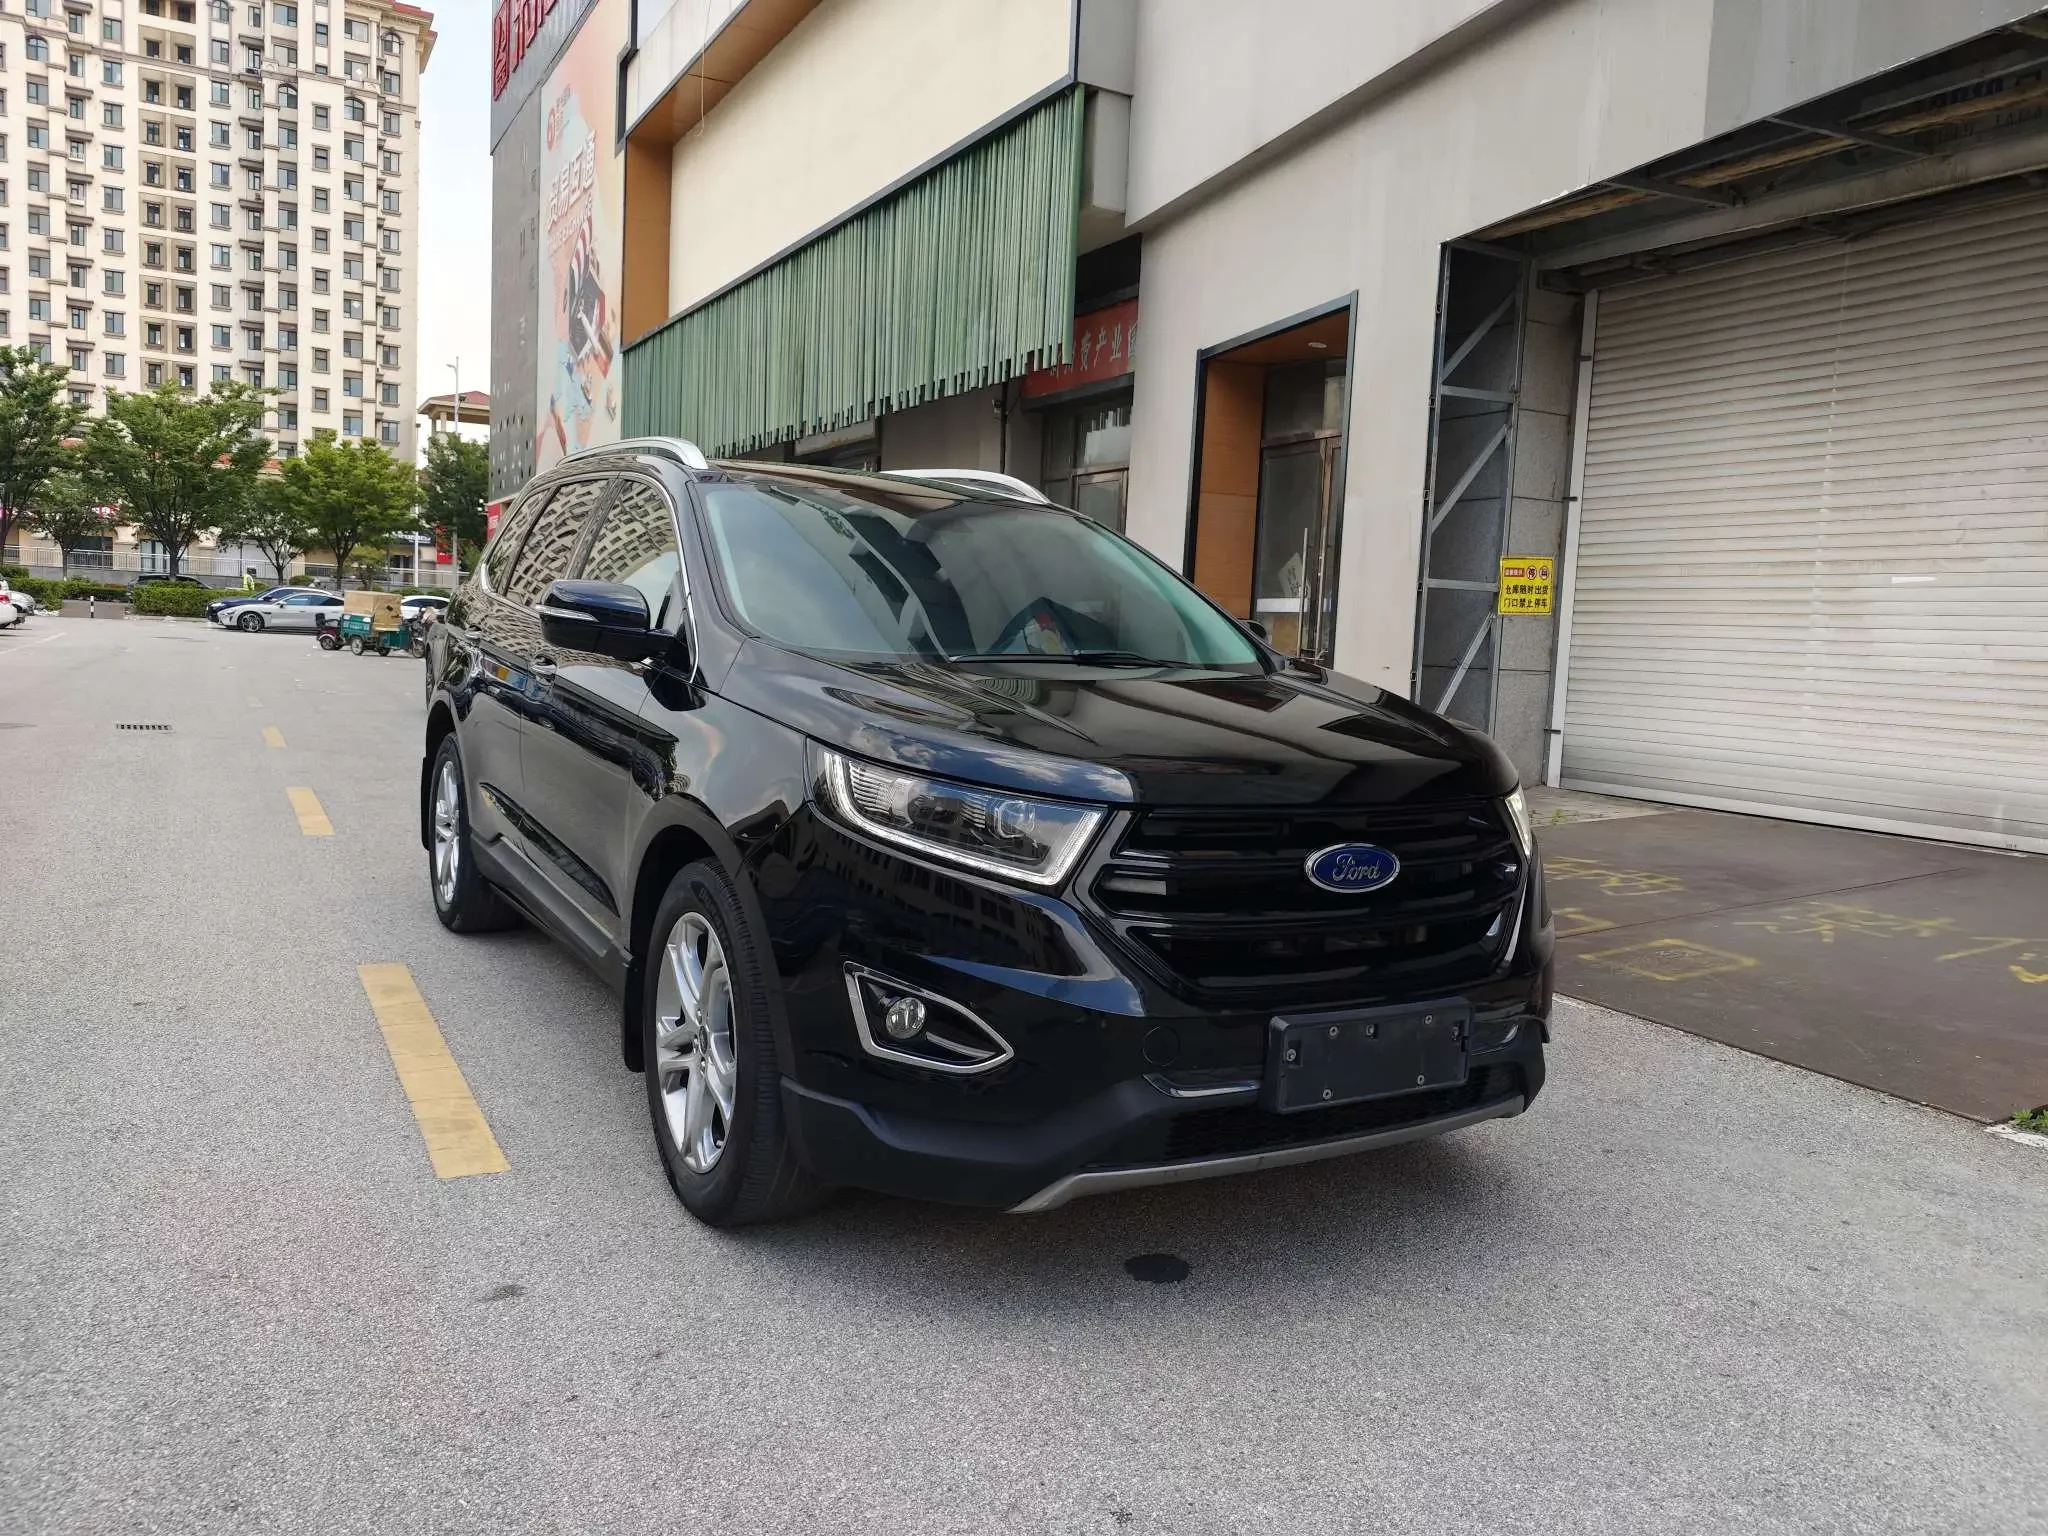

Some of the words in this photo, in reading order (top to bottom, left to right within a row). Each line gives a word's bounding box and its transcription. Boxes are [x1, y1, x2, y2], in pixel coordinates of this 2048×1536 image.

[1503, 598, 1547, 608] 门口禁止停车
[1332, 853, 1381, 881] Ford
